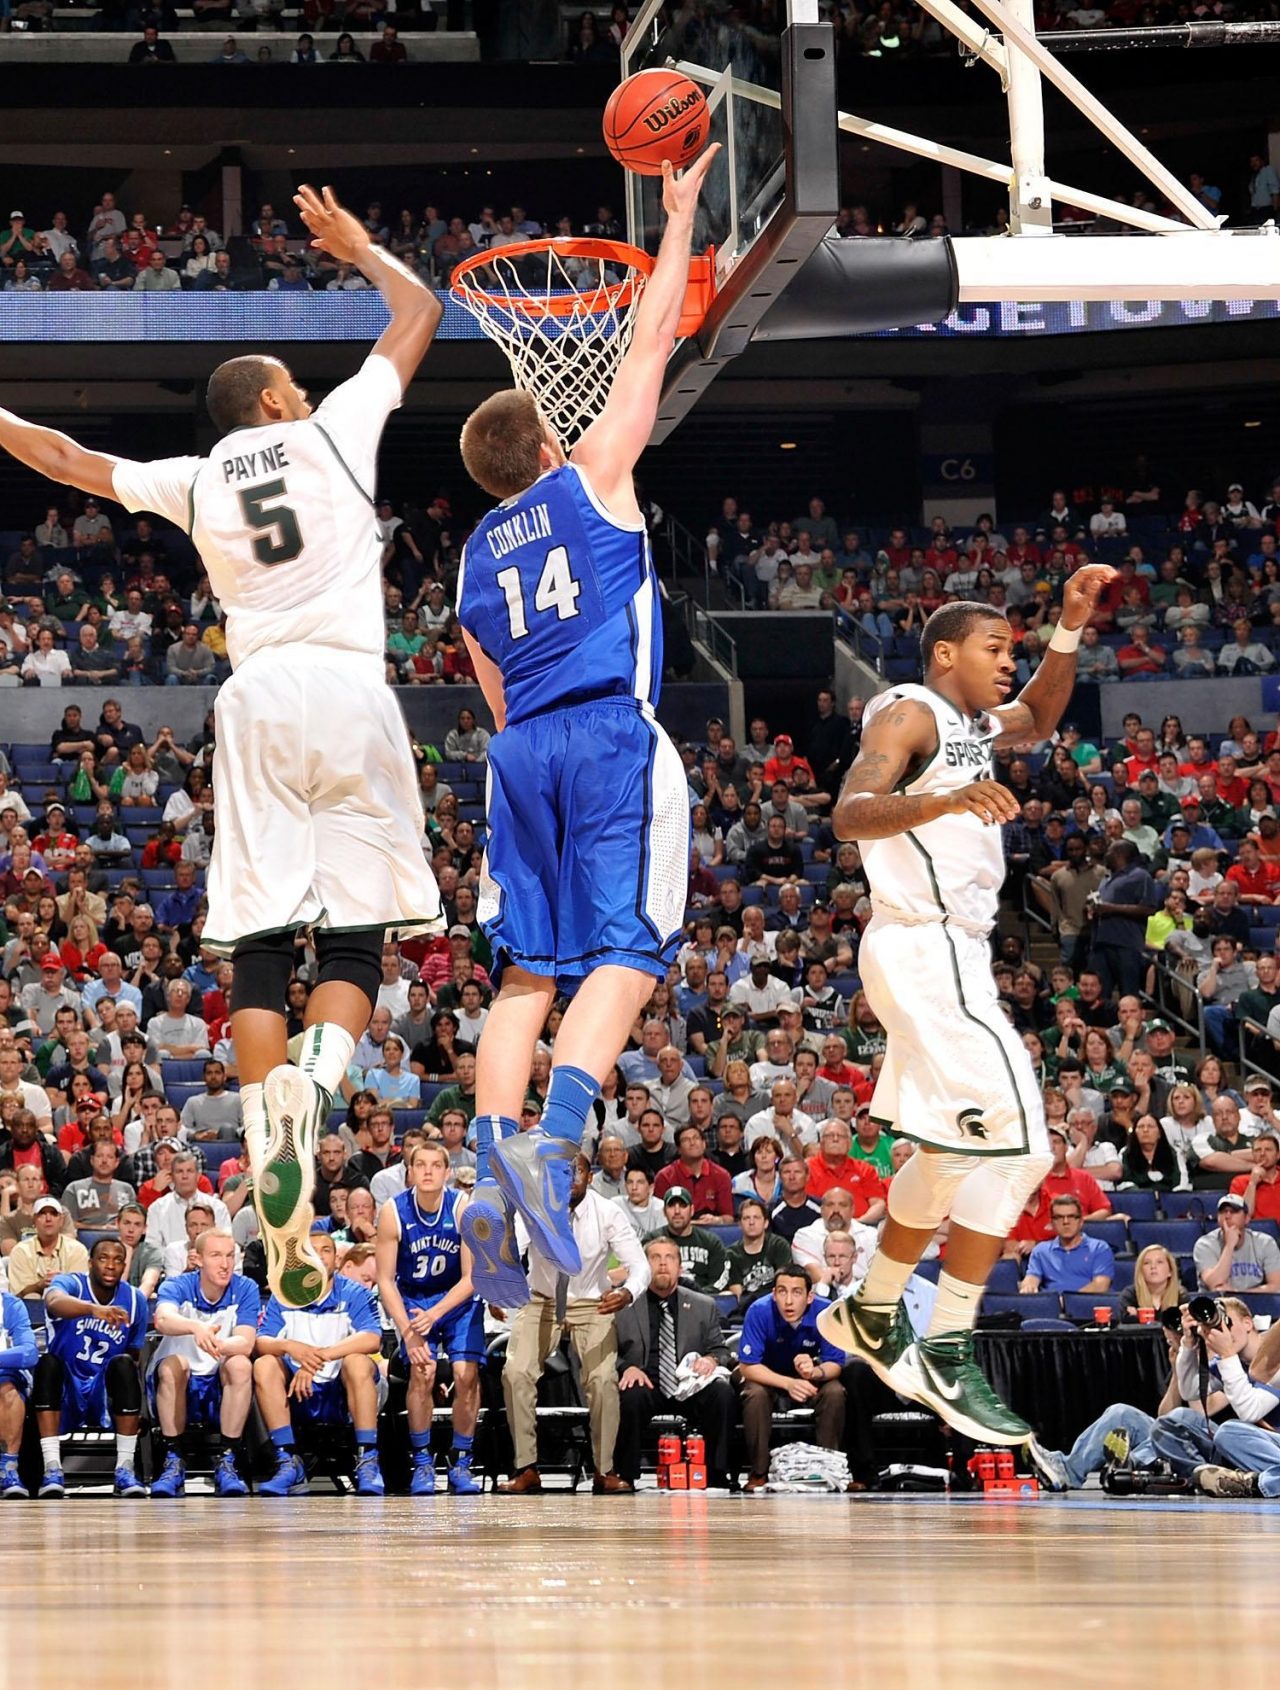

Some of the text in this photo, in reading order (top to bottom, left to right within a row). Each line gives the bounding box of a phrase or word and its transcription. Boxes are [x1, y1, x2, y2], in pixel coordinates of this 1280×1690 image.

[642, 88, 704, 133] Wilson
[221, 441, 290, 484] PAYNE
[940, 459, 976, 480] C6
[235, 476, 305, 568] 5
[486, 503, 552, 560] CONKLIN
[495, 544, 581, 640] 14
[412, 1254, 447, 1279] 30
[75, 1335, 110, 1365] 32
